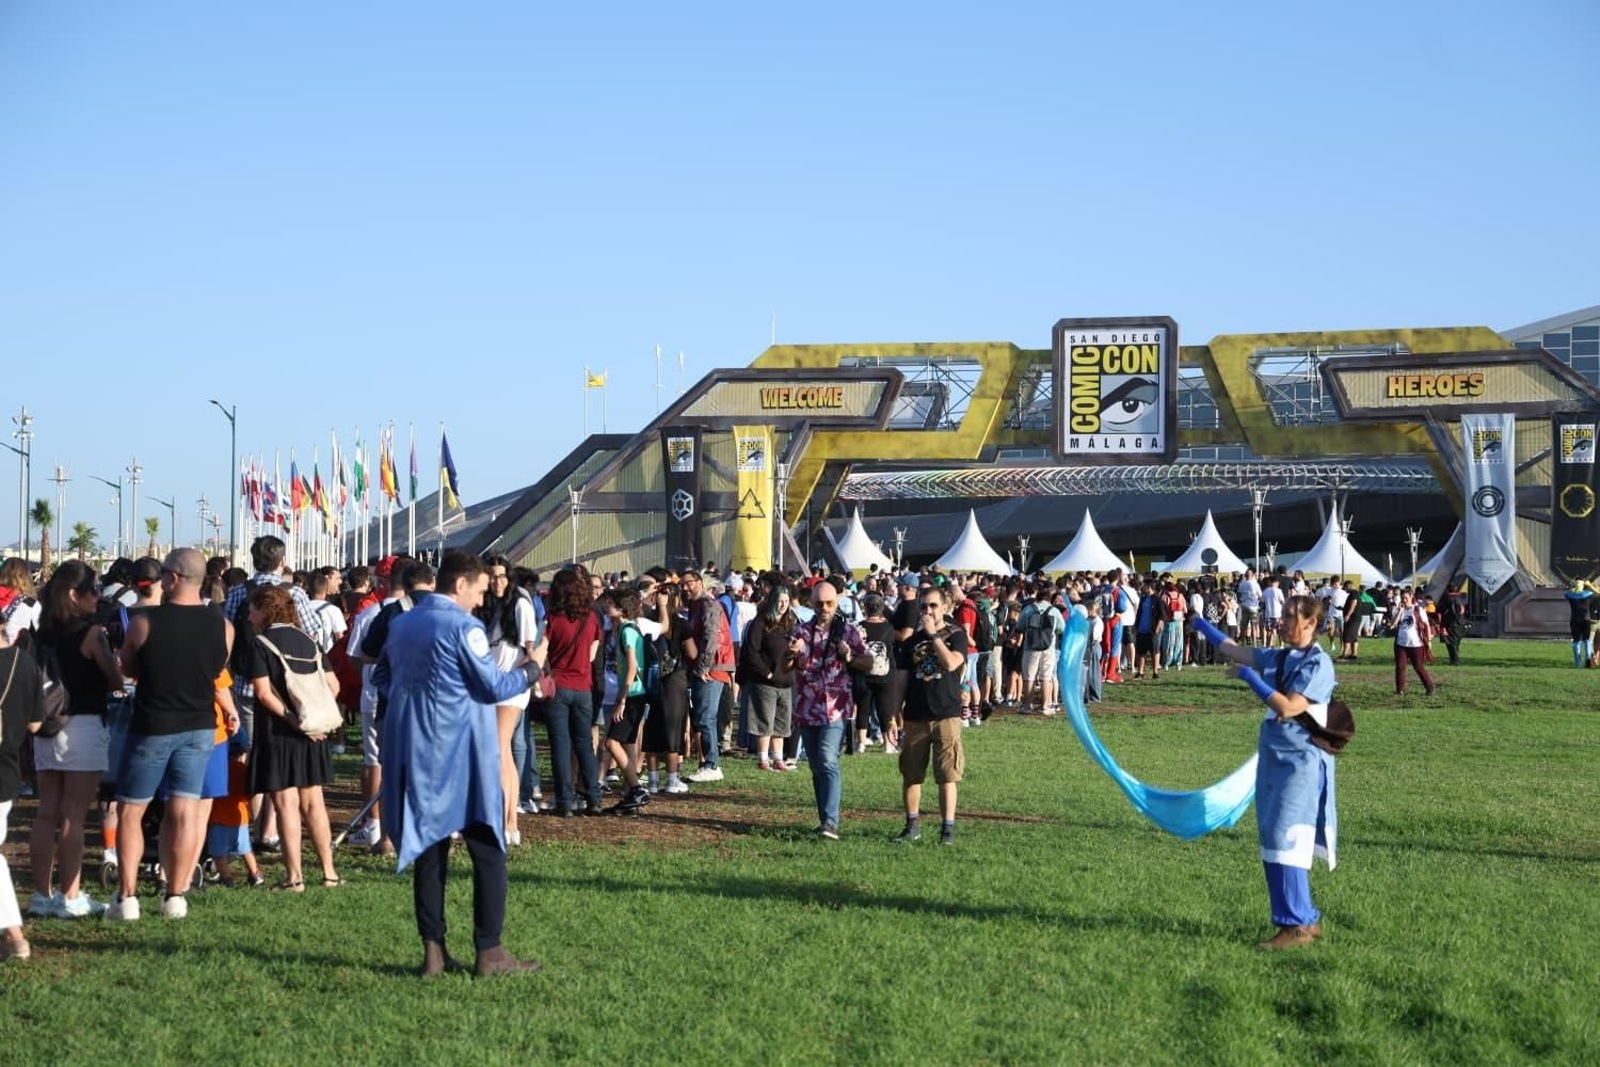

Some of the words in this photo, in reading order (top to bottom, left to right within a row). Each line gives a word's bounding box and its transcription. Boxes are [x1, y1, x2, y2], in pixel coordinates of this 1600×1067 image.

[1070, 334, 1099, 344] SAN
[1111, 333, 1160, 343] DIEGO
[1102, 345, 1159, 374] CON
[1070, 346, 1100, 433] COMIC
[1387, 372, 1486, 398] HEROES
[761, 386, 844, 409] WELCOME
[1070, 435, 1158, 449] MÁLAGA
[1573, 429, 1593, 439] CON
